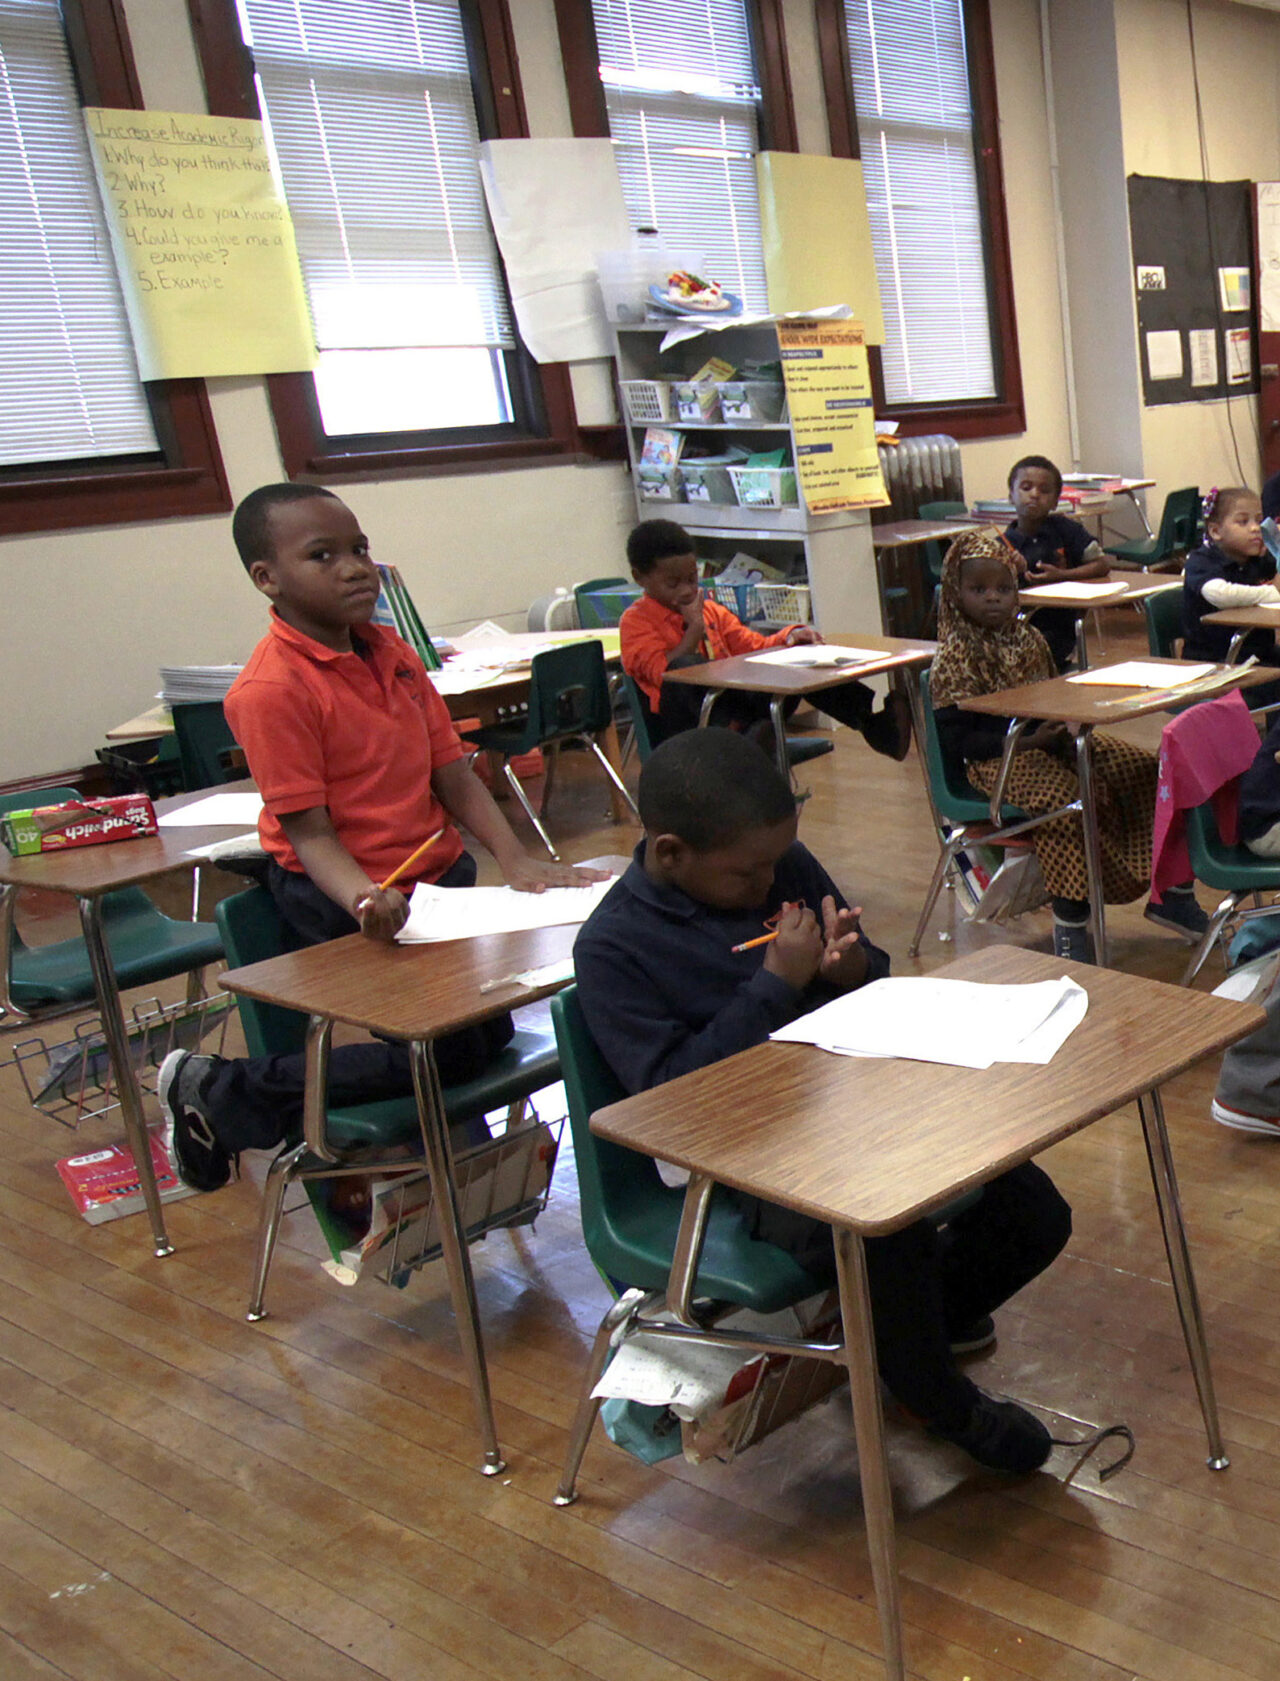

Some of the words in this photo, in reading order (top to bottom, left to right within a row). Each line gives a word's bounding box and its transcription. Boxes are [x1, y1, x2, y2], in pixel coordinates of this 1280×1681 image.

[90, 110, 170, 141] Increase
[148, 147, 169, 168] do
[172, 156, 199, 175] you
[134, 198, 174, 219] How
[182, 201, 206, 219] do
[16, 832, 39, 844] 40
